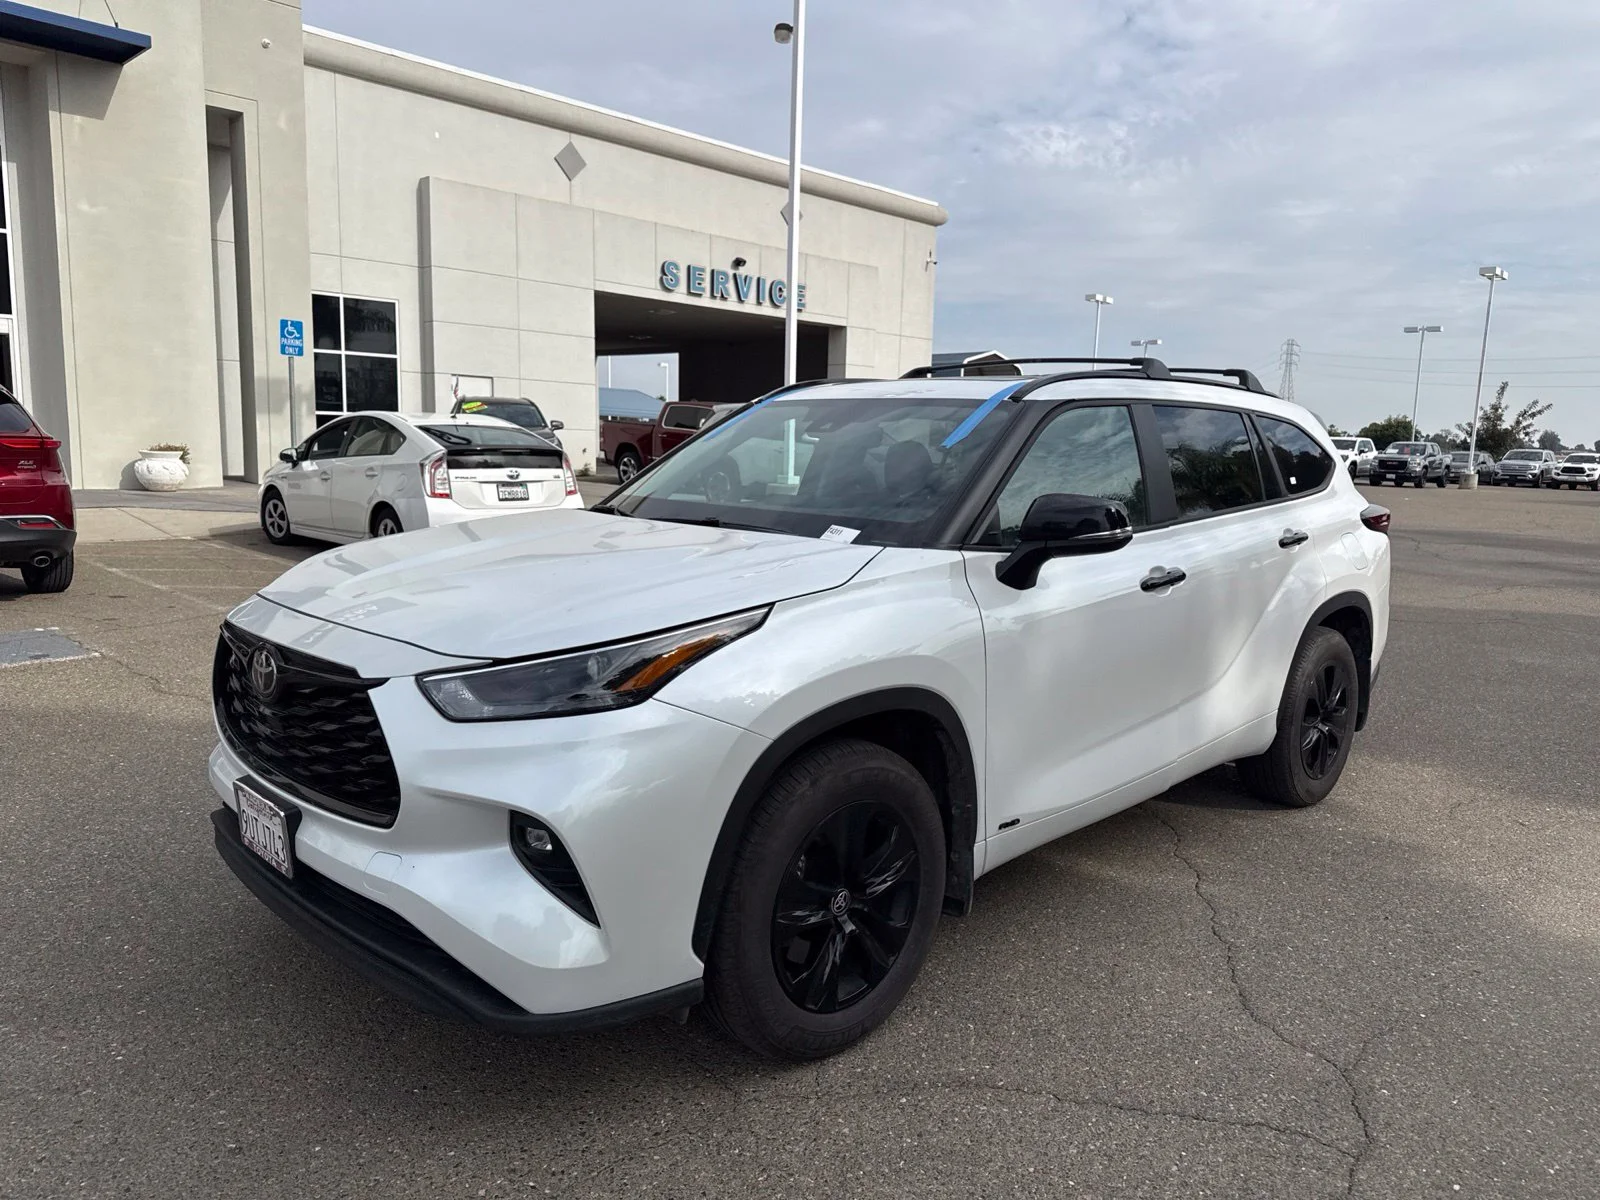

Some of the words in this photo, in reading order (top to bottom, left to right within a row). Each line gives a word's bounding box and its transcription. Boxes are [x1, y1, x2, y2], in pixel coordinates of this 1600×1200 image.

[660, 260, 806, 312] SERVICE
[281, 337, 303, 347] PARKING
[285, 345, 299, 354] ONLY
